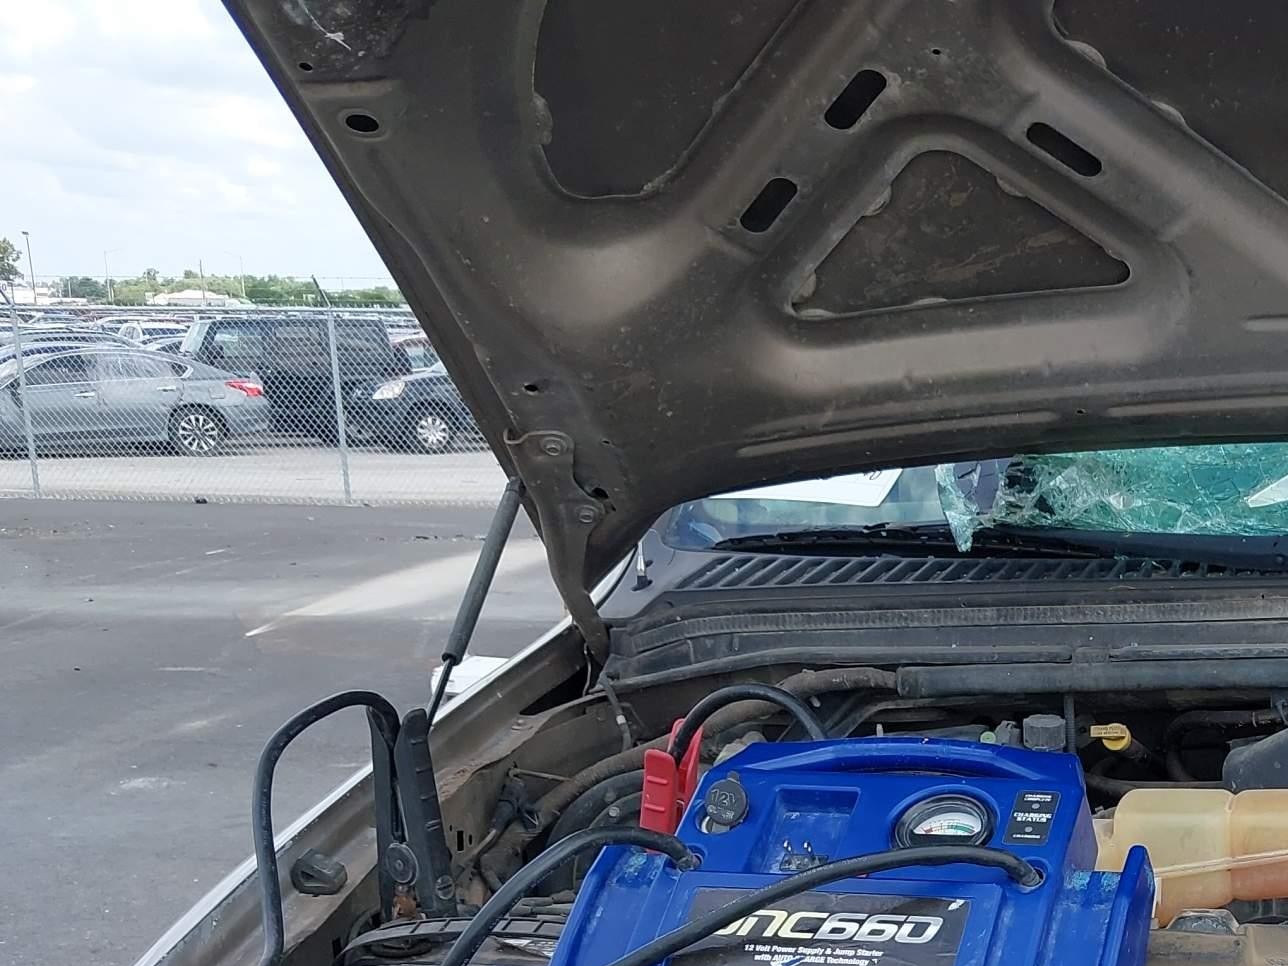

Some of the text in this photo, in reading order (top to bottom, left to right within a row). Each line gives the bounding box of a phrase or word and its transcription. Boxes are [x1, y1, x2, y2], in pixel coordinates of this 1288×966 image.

[771, 945, 796, 953] Power
[797, 946, 824, 955] Supply
[832, 947, 855, 957] Jump
[857, 948, 884, 957] Starter
[754, 953, 771, 961] with
[826, 956, 869, 966] Technology
